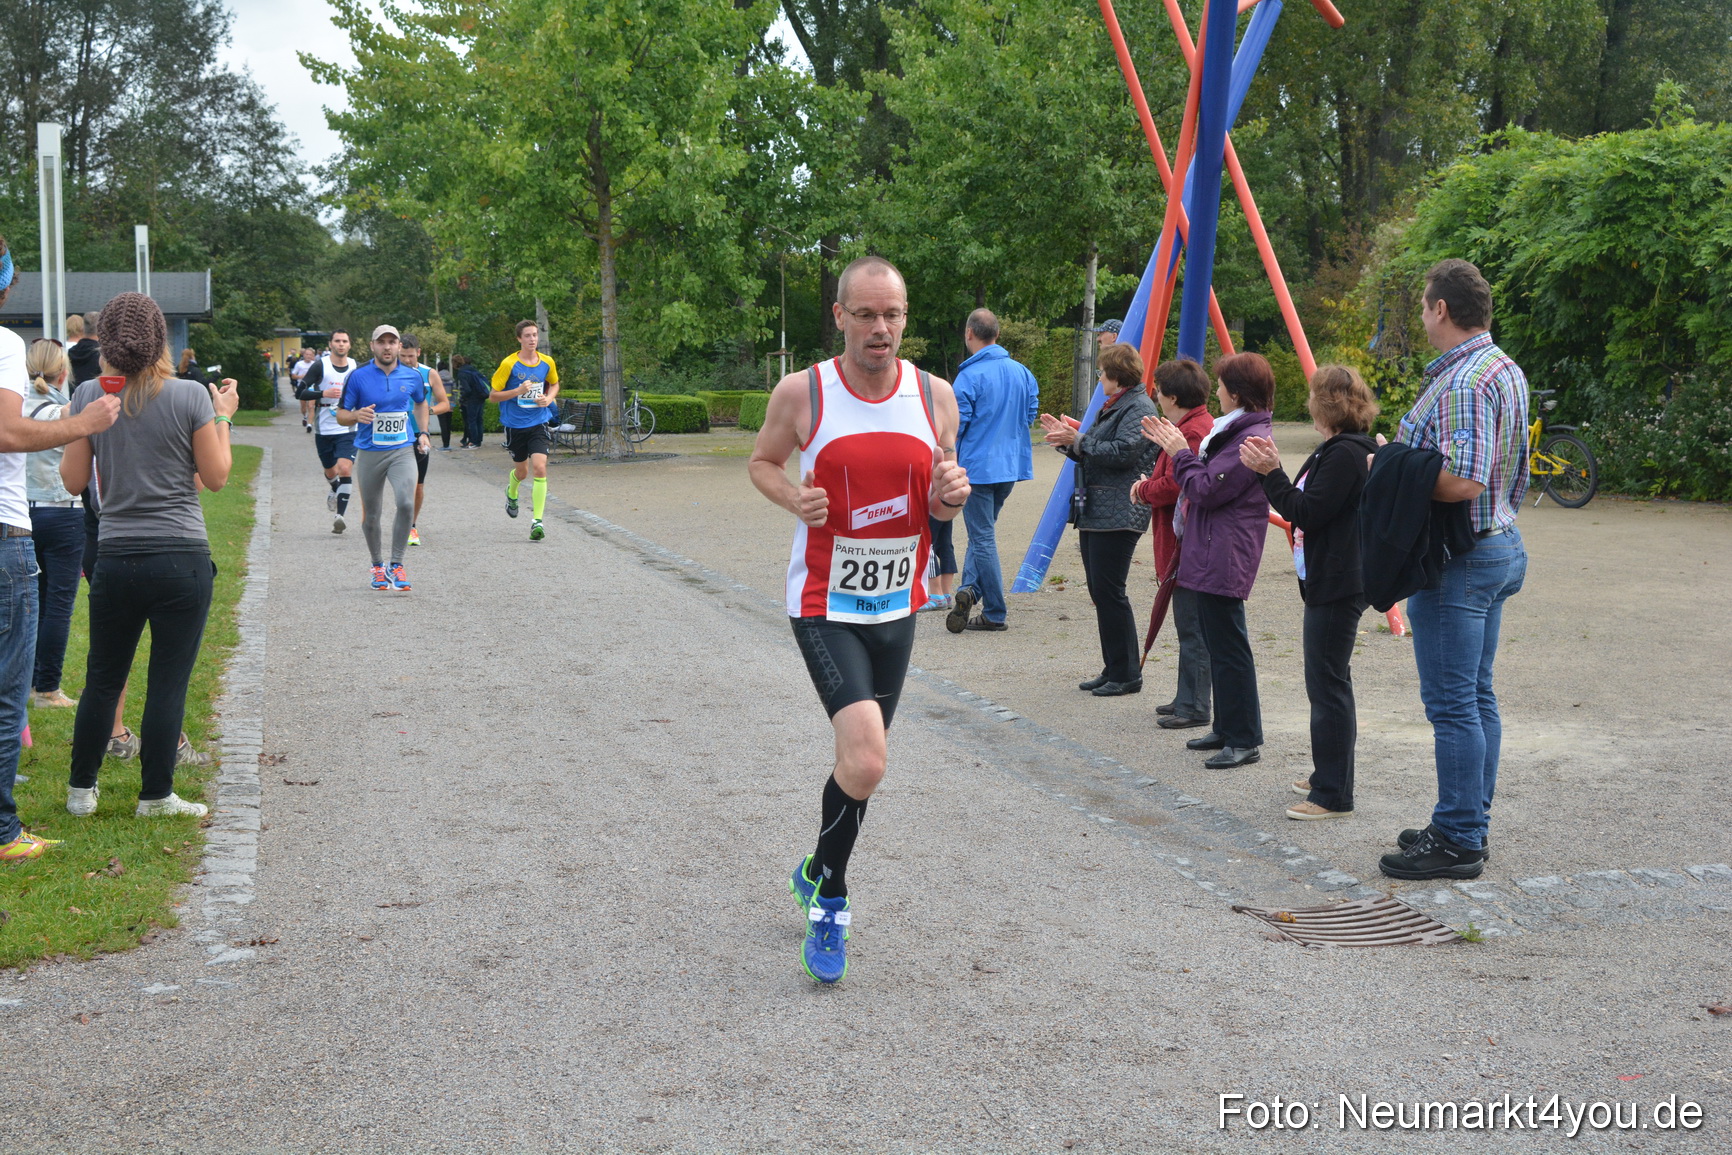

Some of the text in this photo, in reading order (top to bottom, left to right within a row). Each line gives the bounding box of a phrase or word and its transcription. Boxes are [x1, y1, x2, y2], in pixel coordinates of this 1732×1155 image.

[377, 420, 404, 432] 2890
[867, 505, 893, 519] DEHN
[835, 544, 908, 556] PARTL Neumarkt
[839, 557, 910, 591] 2819
[856, 599, 890, 612] Rainer
